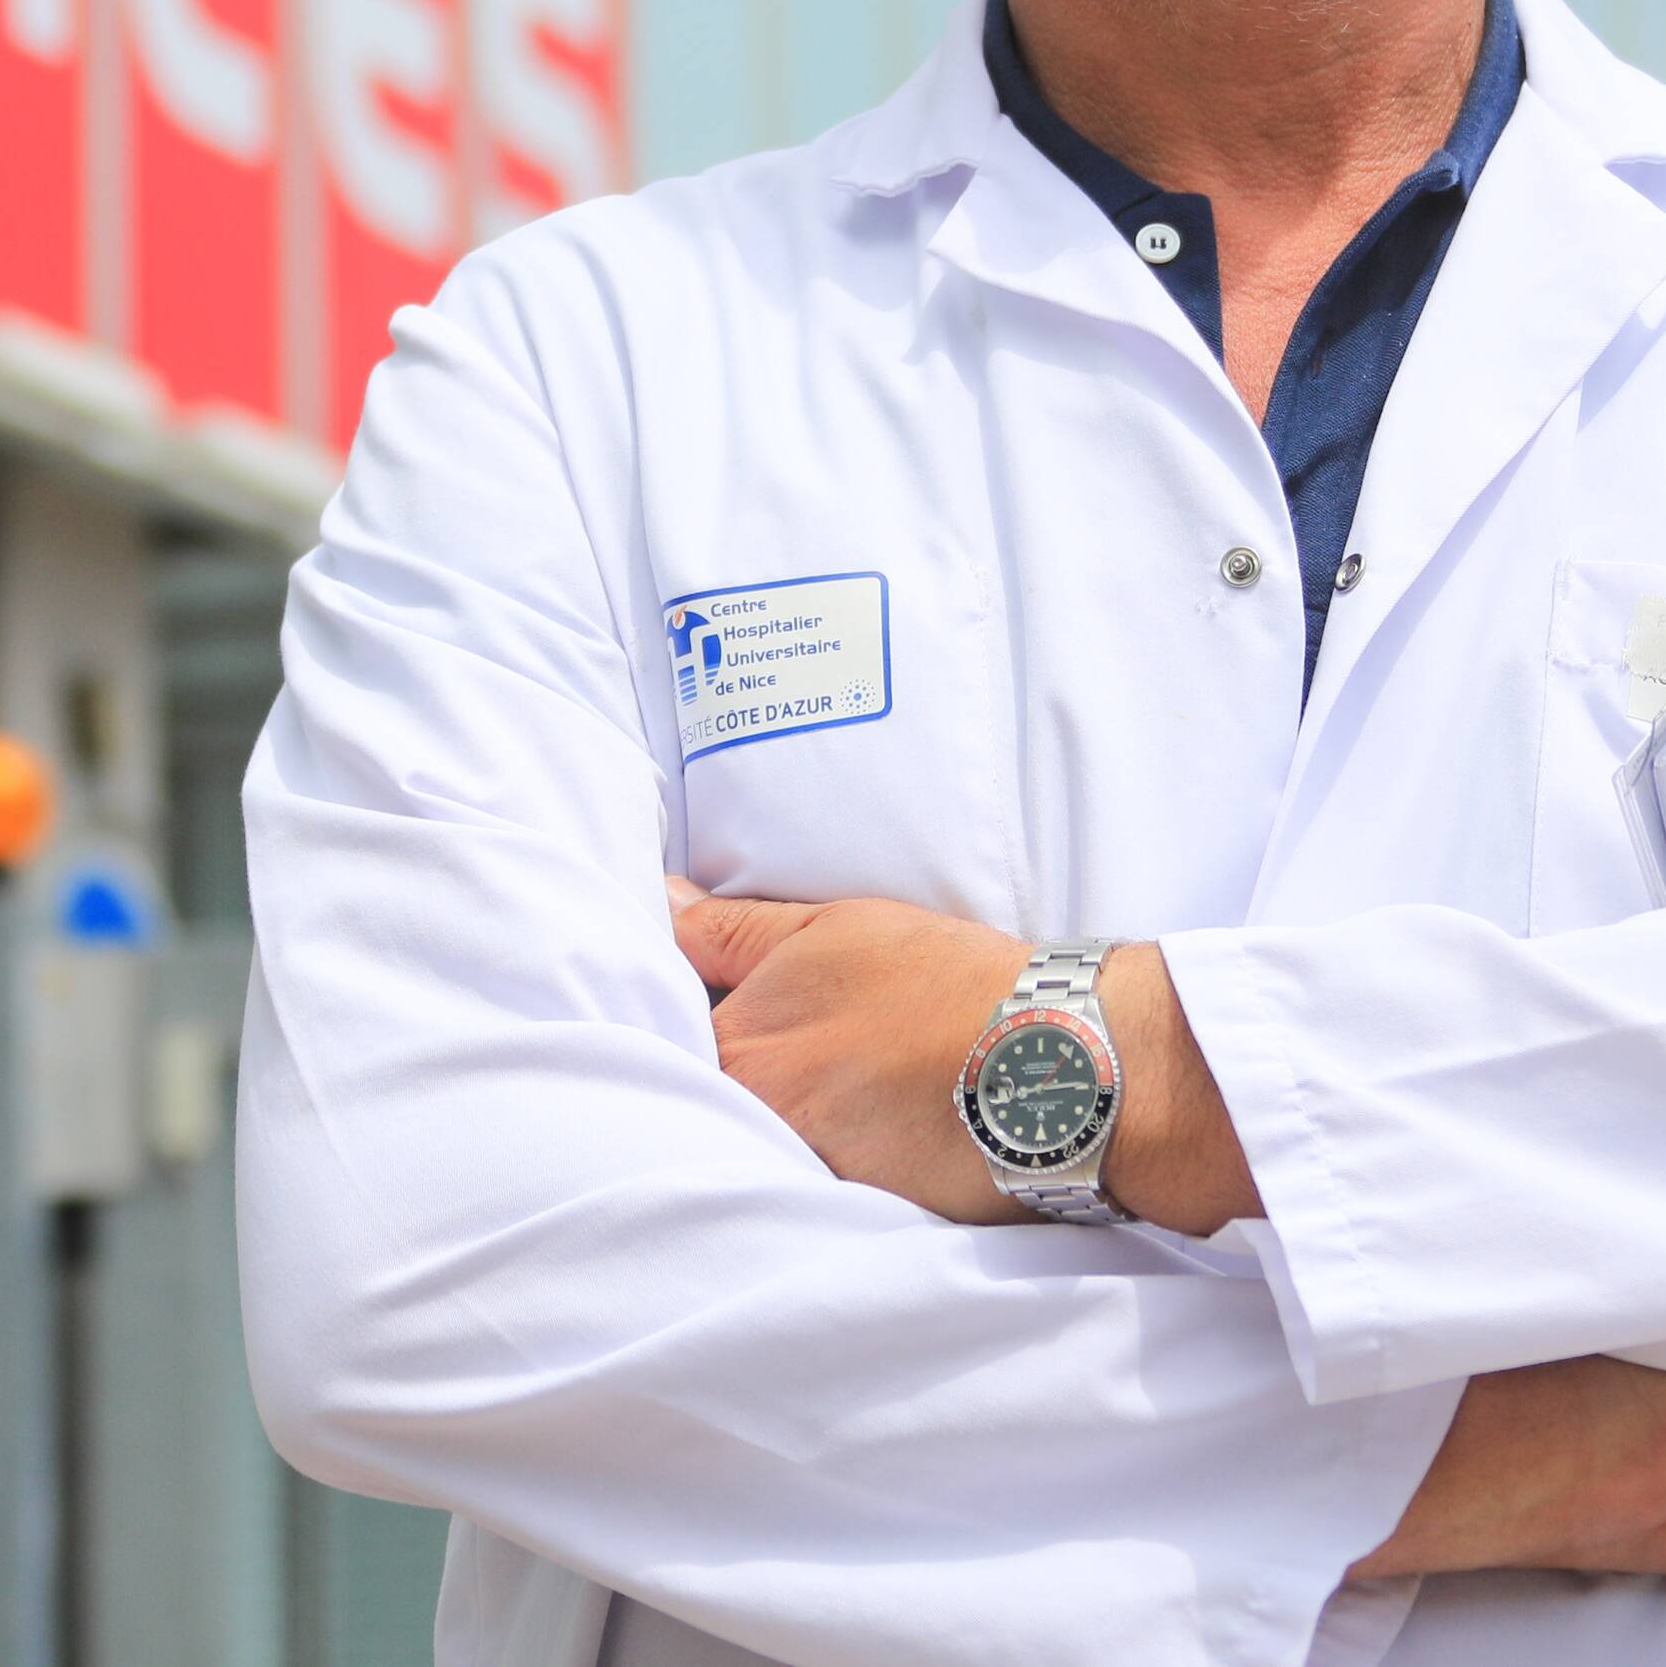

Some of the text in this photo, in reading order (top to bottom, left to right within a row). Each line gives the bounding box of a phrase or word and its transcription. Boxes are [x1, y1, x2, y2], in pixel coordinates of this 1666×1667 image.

[710, 599, 767, 618] Centre
[723, 616, 823, 641] Hospitalier
[726, 639, 841, 667] Universitaire
[715, 674, 777, 696] de Nice
[715, 707, 760, 732] CÔTE
[766, 695, 833, 722] D'AZUR
[1034, 1009, 1047, 1023] 12
[998, 1019, 1014, 1035] 10
[973, 1118, 983, 1130] 4
[1087, 1112, 1105, 1133] 20
[997, 1144, 1008, 1158] 2
[1061, 1140, 1079, 1159] 22
